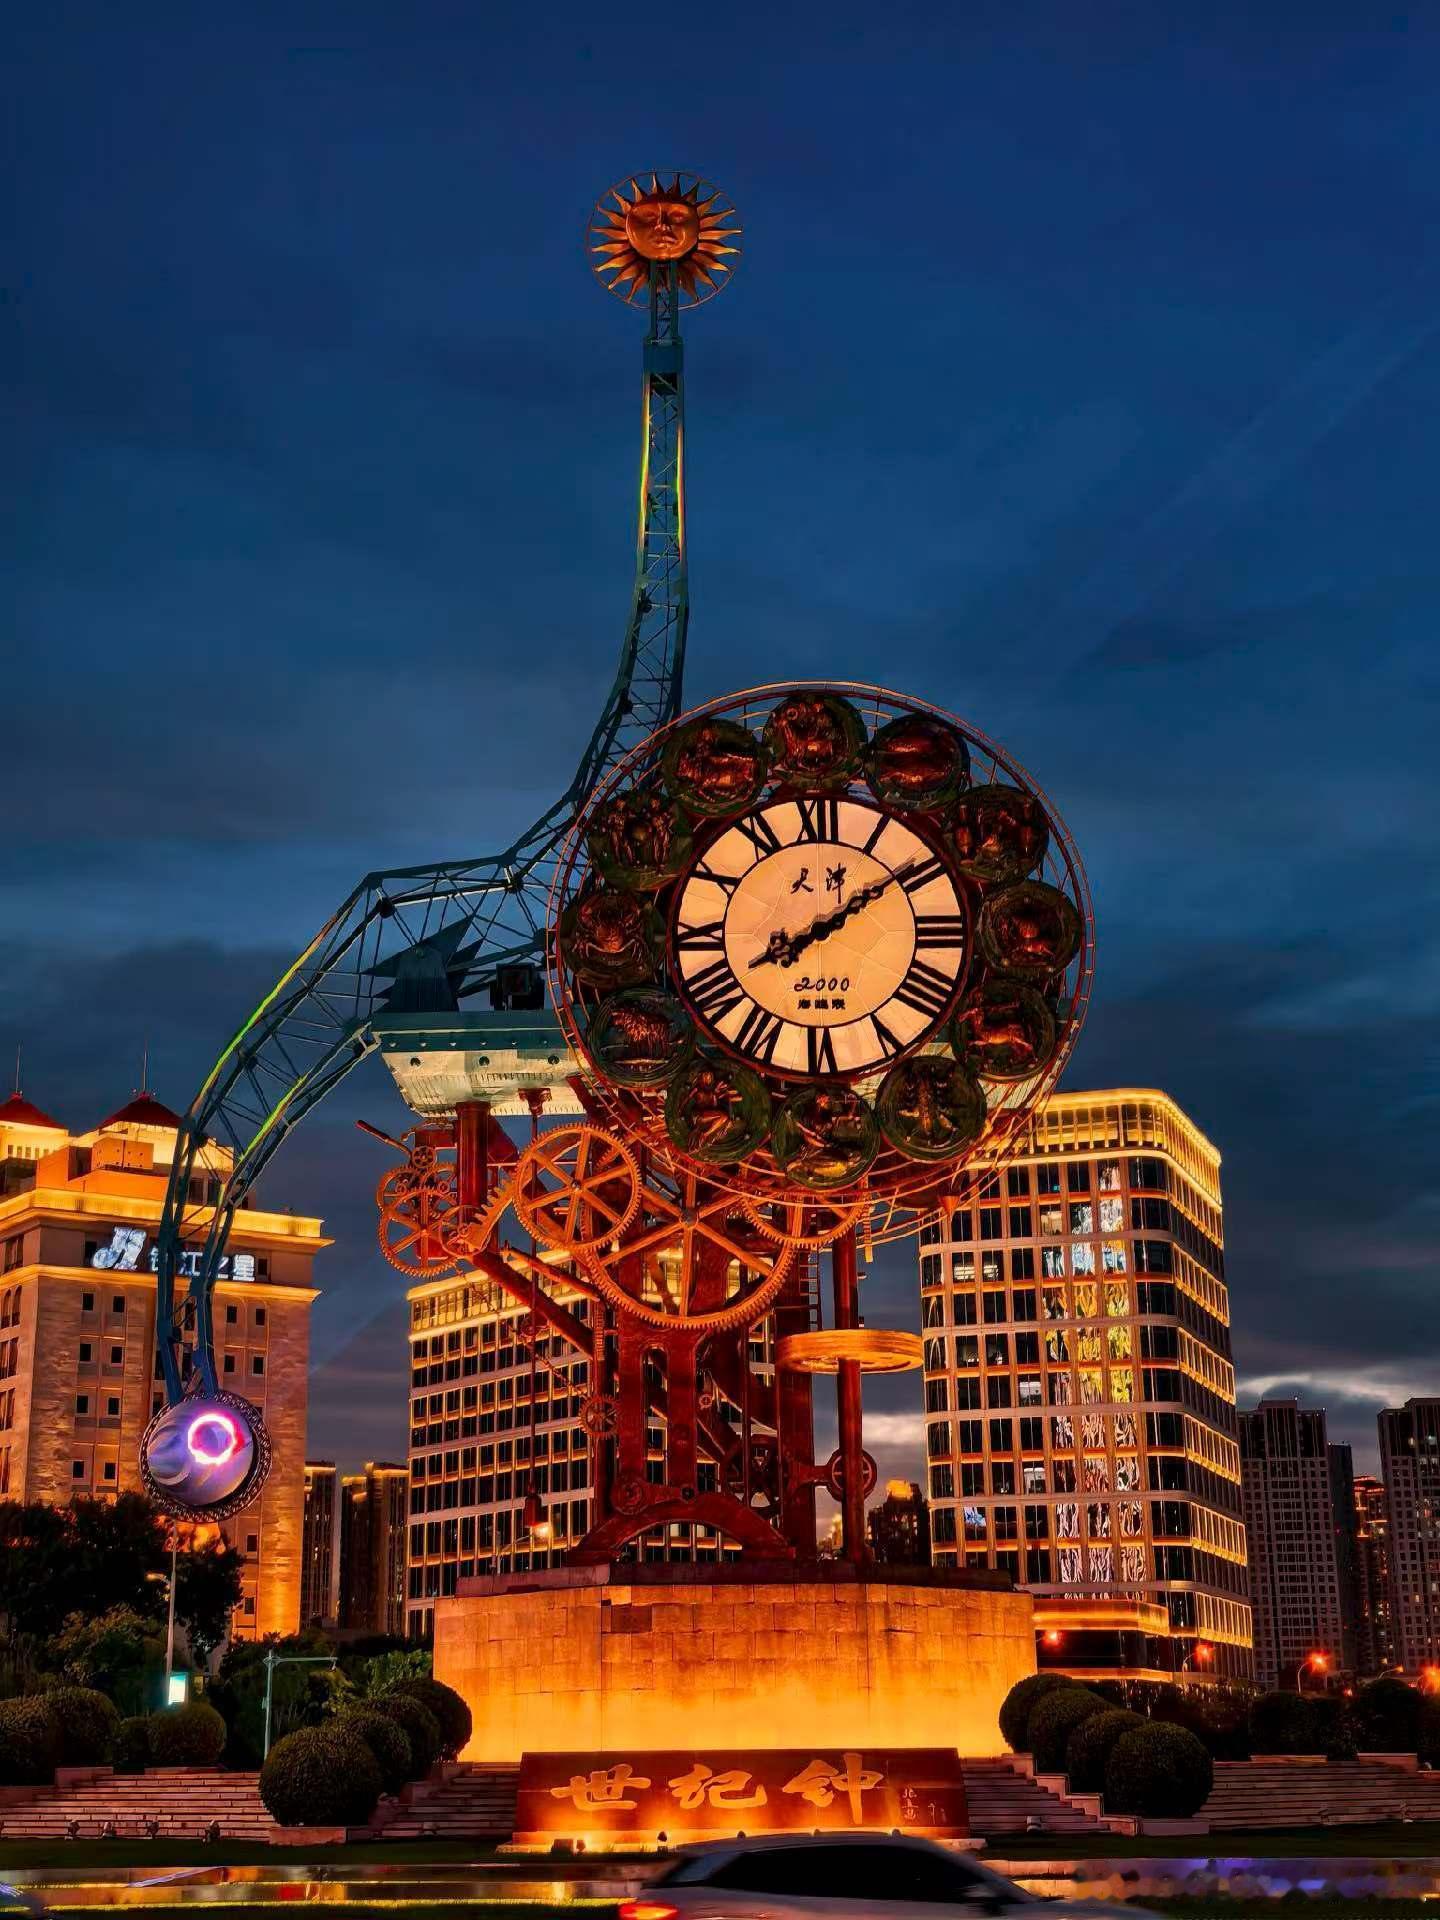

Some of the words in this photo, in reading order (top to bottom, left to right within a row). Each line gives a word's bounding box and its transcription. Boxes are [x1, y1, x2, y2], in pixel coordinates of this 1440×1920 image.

[732, 813, 782, 863] XI
[795, 799, 839, 843] XII
[790, 862, 847, 904] 天津
[677, 920, 724, 952] IX
[915, 915, 963, 949] III
[684, 959, 748, 1027] VIII
[794, 976, 850, 992] 2000
[732, 1004, 784, 1065] VII
[807, 1027, 838, 1074] VI
[870, 1012, 905, 1058] V
[550, 1752, 884, 1825] 世纪钟
